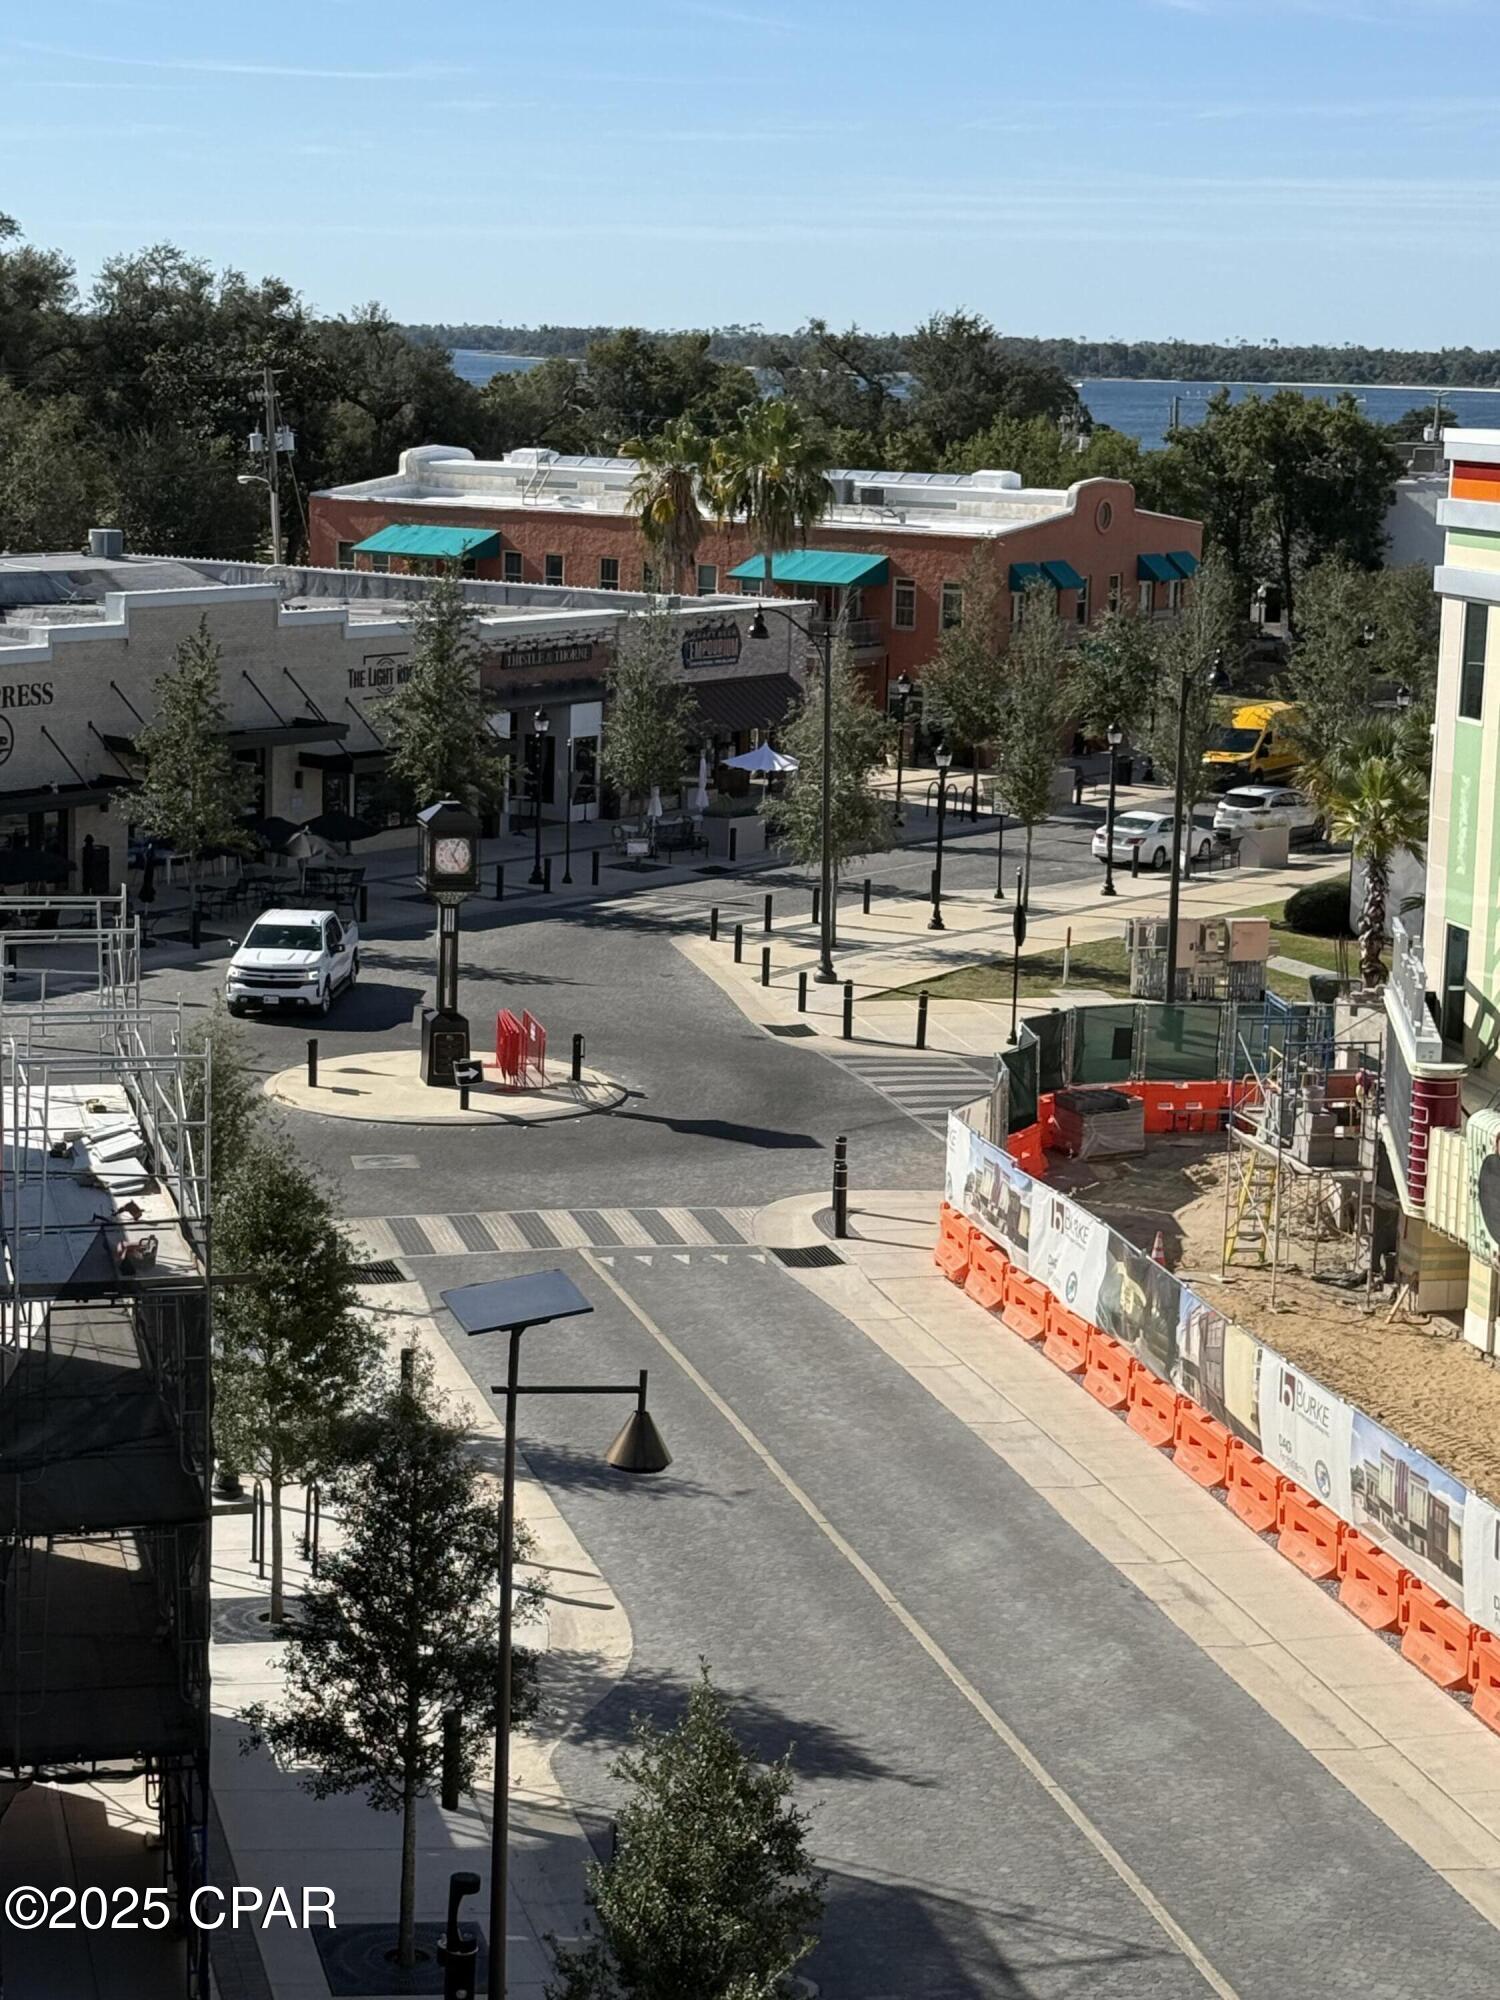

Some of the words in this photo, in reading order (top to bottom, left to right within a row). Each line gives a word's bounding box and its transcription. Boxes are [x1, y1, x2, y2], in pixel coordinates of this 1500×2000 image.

[347, 668, 366, 688] THE
[368, 666, 394, 687] LIGHT
[1295, 1379, 1330, 1428] BURKE
